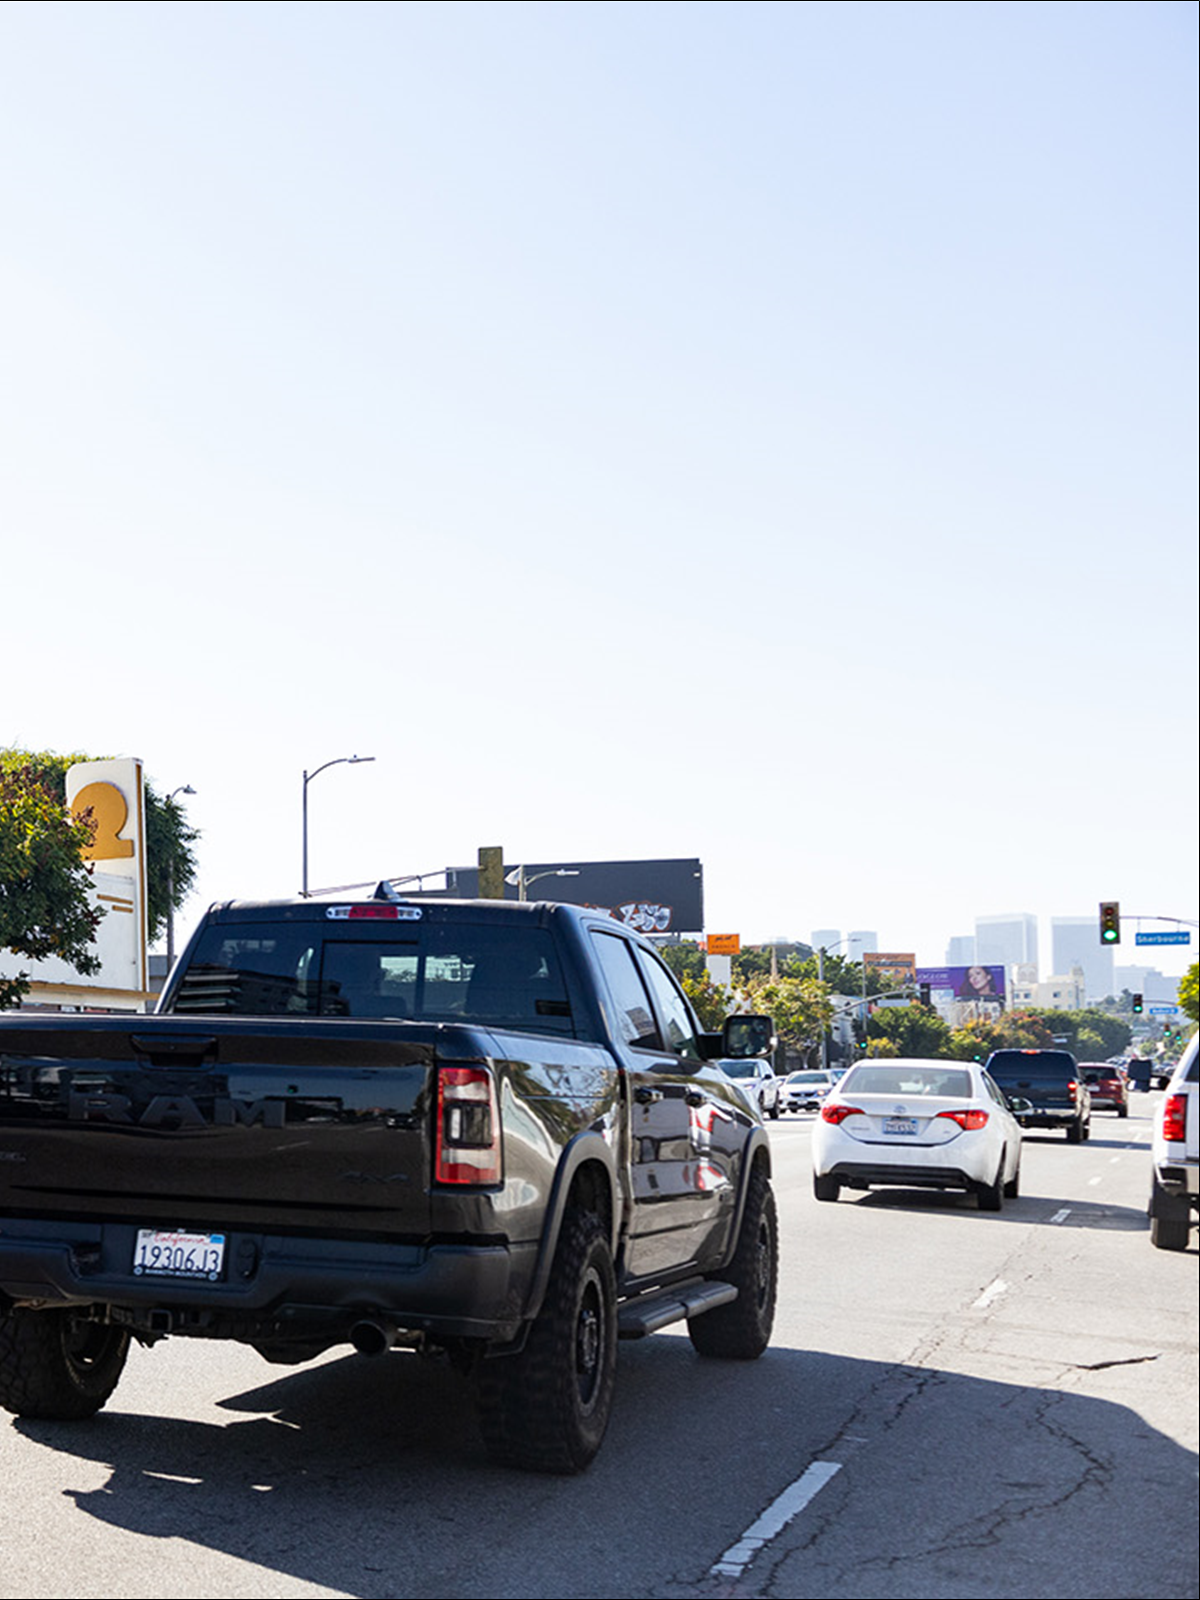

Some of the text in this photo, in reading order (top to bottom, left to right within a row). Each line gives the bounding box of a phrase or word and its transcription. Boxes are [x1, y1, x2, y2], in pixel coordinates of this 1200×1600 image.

[1138, 935, 1189, 943] Sherbourne
[68, 1092, 287, 1130] RAM
[153, 1232, 206, 1246] California
[140, 1244, 220, 1272] 19306J3
